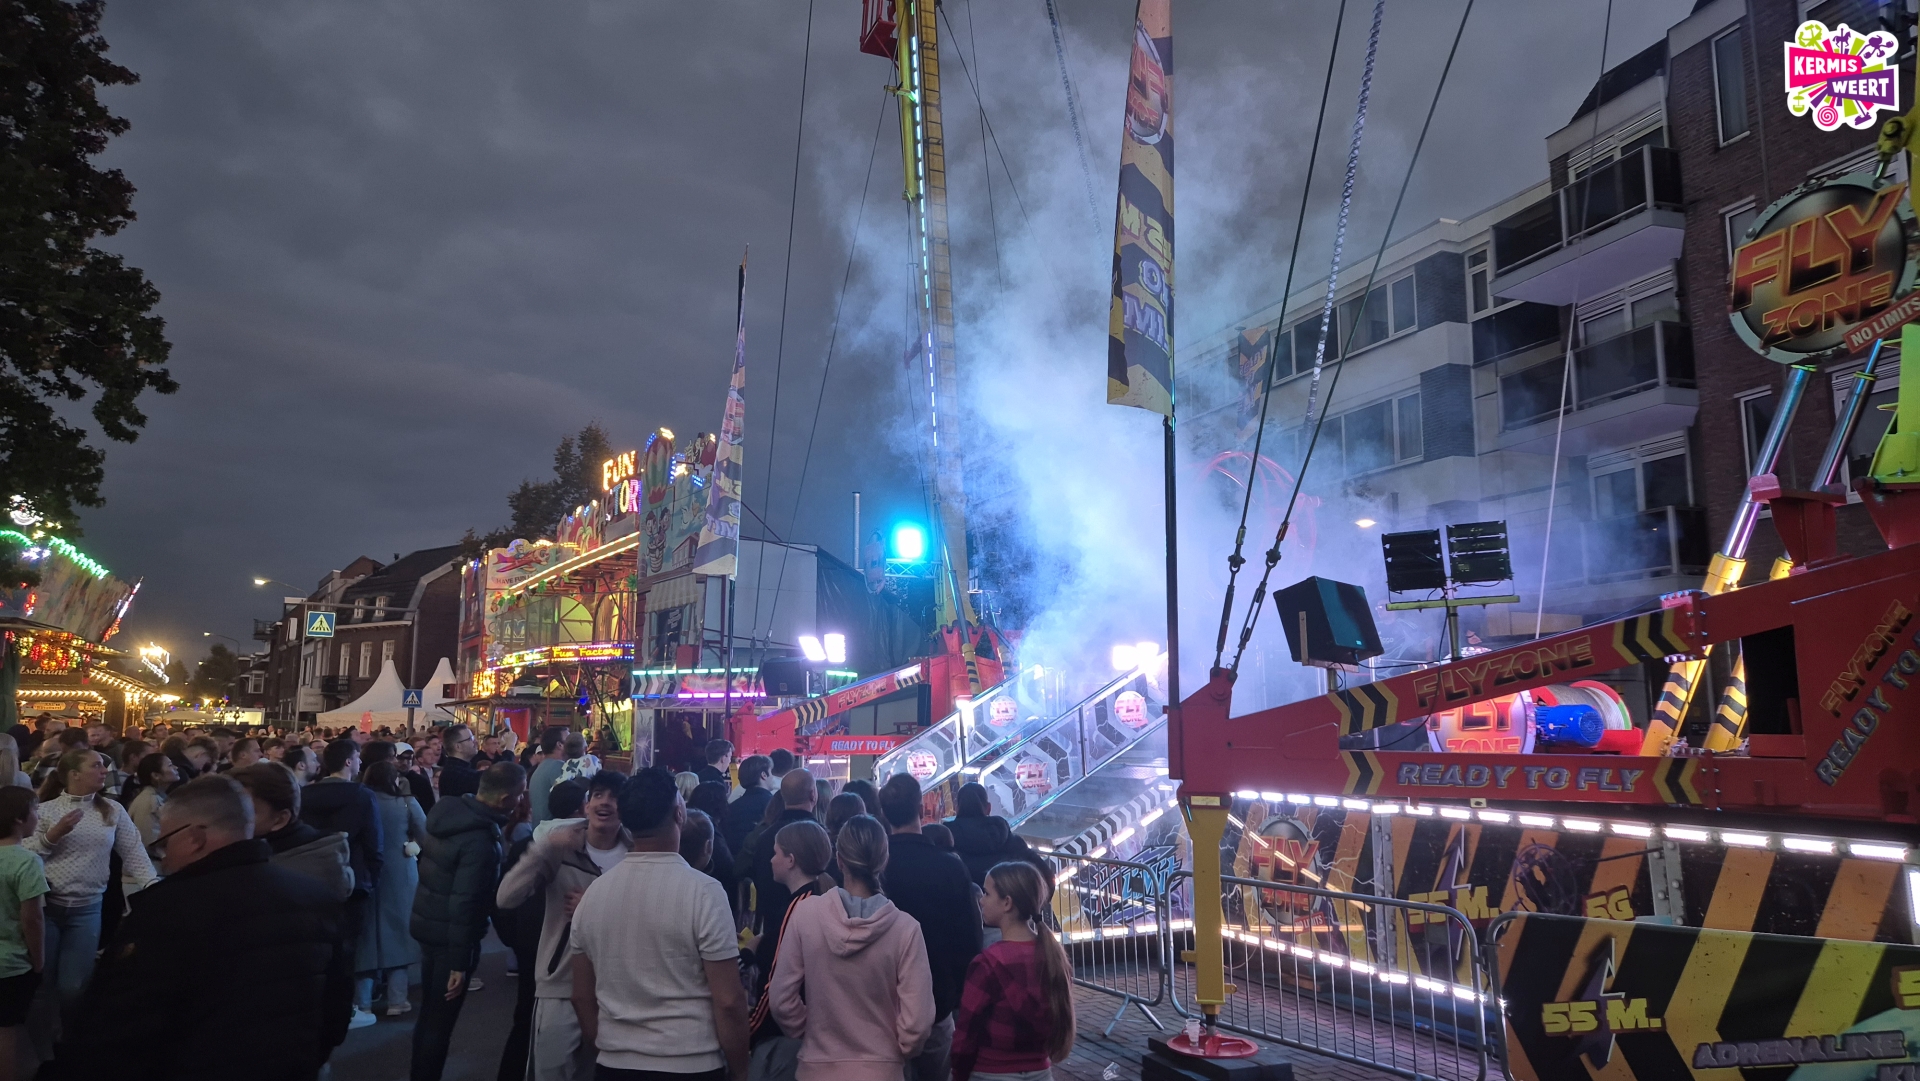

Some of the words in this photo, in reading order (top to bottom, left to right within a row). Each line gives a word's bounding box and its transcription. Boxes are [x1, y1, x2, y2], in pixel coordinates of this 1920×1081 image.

[1731, 181, 1907, 312] FLY
[1760, 271, 1894, 349] ZONE
[1850, 327, 1873, 347] NO
[1872, 297, 1920, 334] LIMITS
[602, 450, 636, 491] FUN
[514, 575, 527, 583] FUN
[552, 647, 575, 658] Fun
[579, 647, 622, 657] Factory
[1815, 685, 1893, 787] READY
[1883, 649, 1920, 690] TO
[831, 740, 863, 751] READY
[864, 740, 878, 751] TO
[878, 740, 896, 751] FLY
[1015, 763, 1048, 779] FLY
[1396, 762, 1516, 789] READY
[1523, 765, 1571, 790] TO
[1576, 767, 1643, 792] FLY
[1250, 836, 1320, 885] FLY
[1408, 891, 1450, 925] 55
[1585, 886, 1634, 921] 5G
[1543, 1002, 1598, 1032] 55
[1607, 999, 1662, 1030] M.
[1695, 1031, 1906, 1068] ADRENALINE
